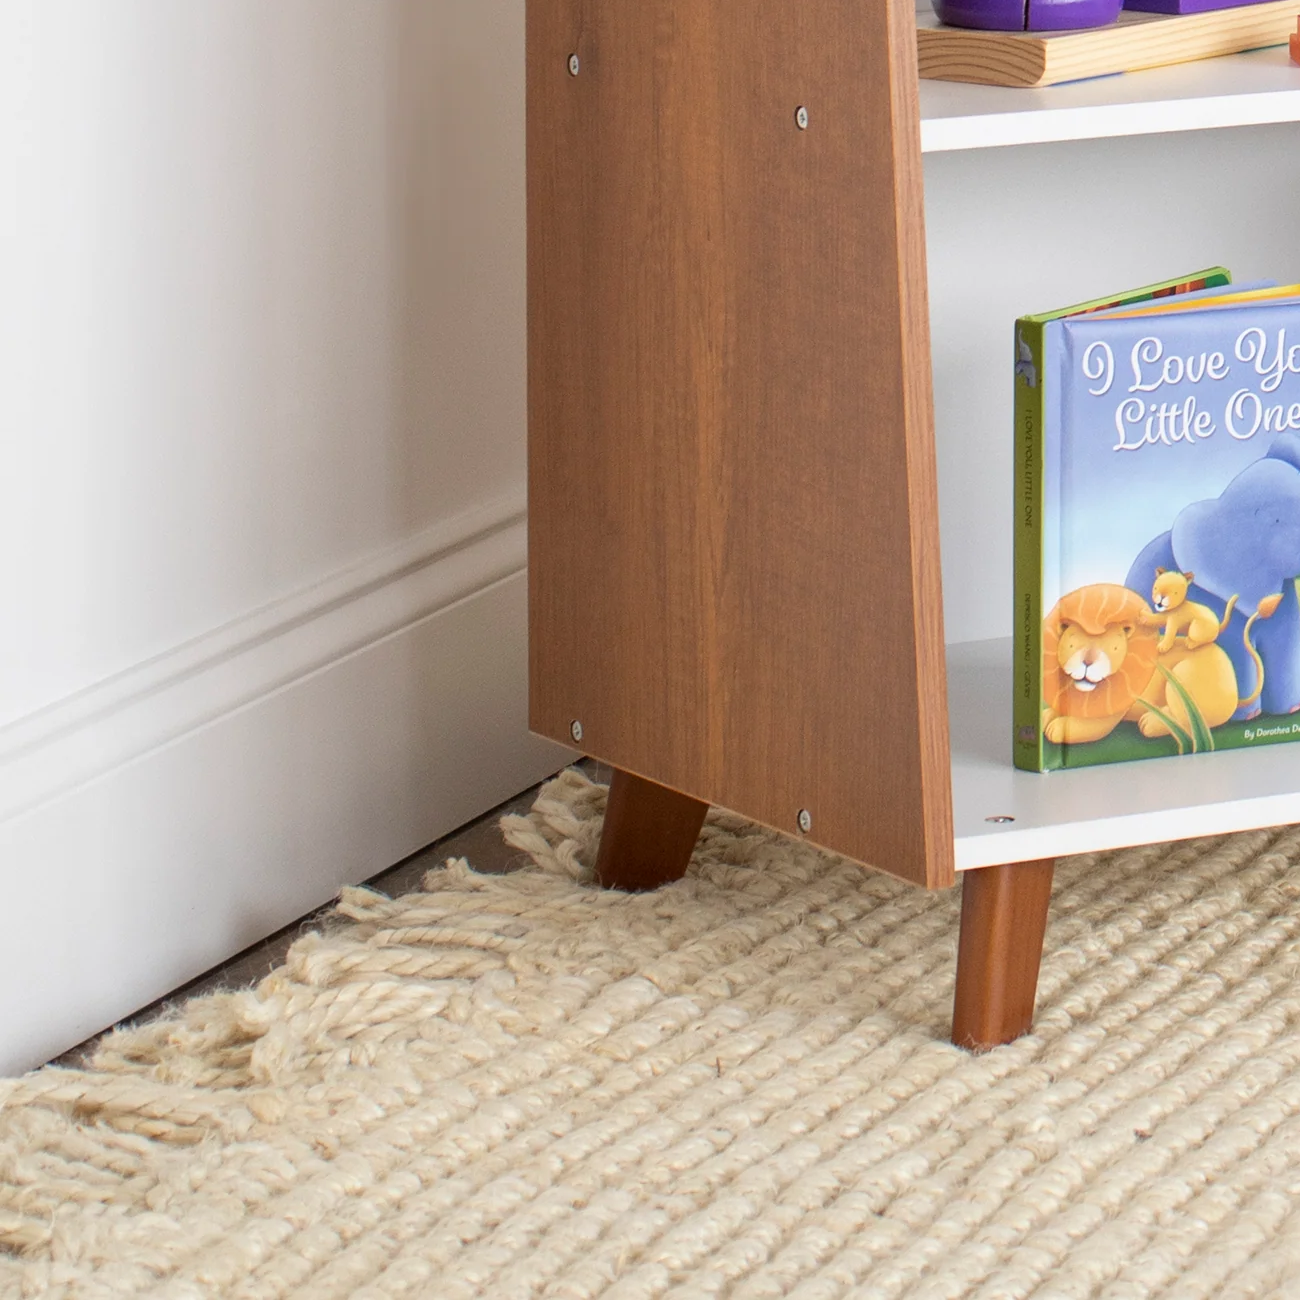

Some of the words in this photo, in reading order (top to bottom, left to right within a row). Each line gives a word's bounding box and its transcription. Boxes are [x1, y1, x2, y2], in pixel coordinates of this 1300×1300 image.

[1081, 340, 1115, 395] I
[1126, 336, 1230, 395] Love
[1112, 397, 1216, 452] Little
[1244, 729, 1255, 740] By
[1256, 726, 1290, 737] Dorothea
